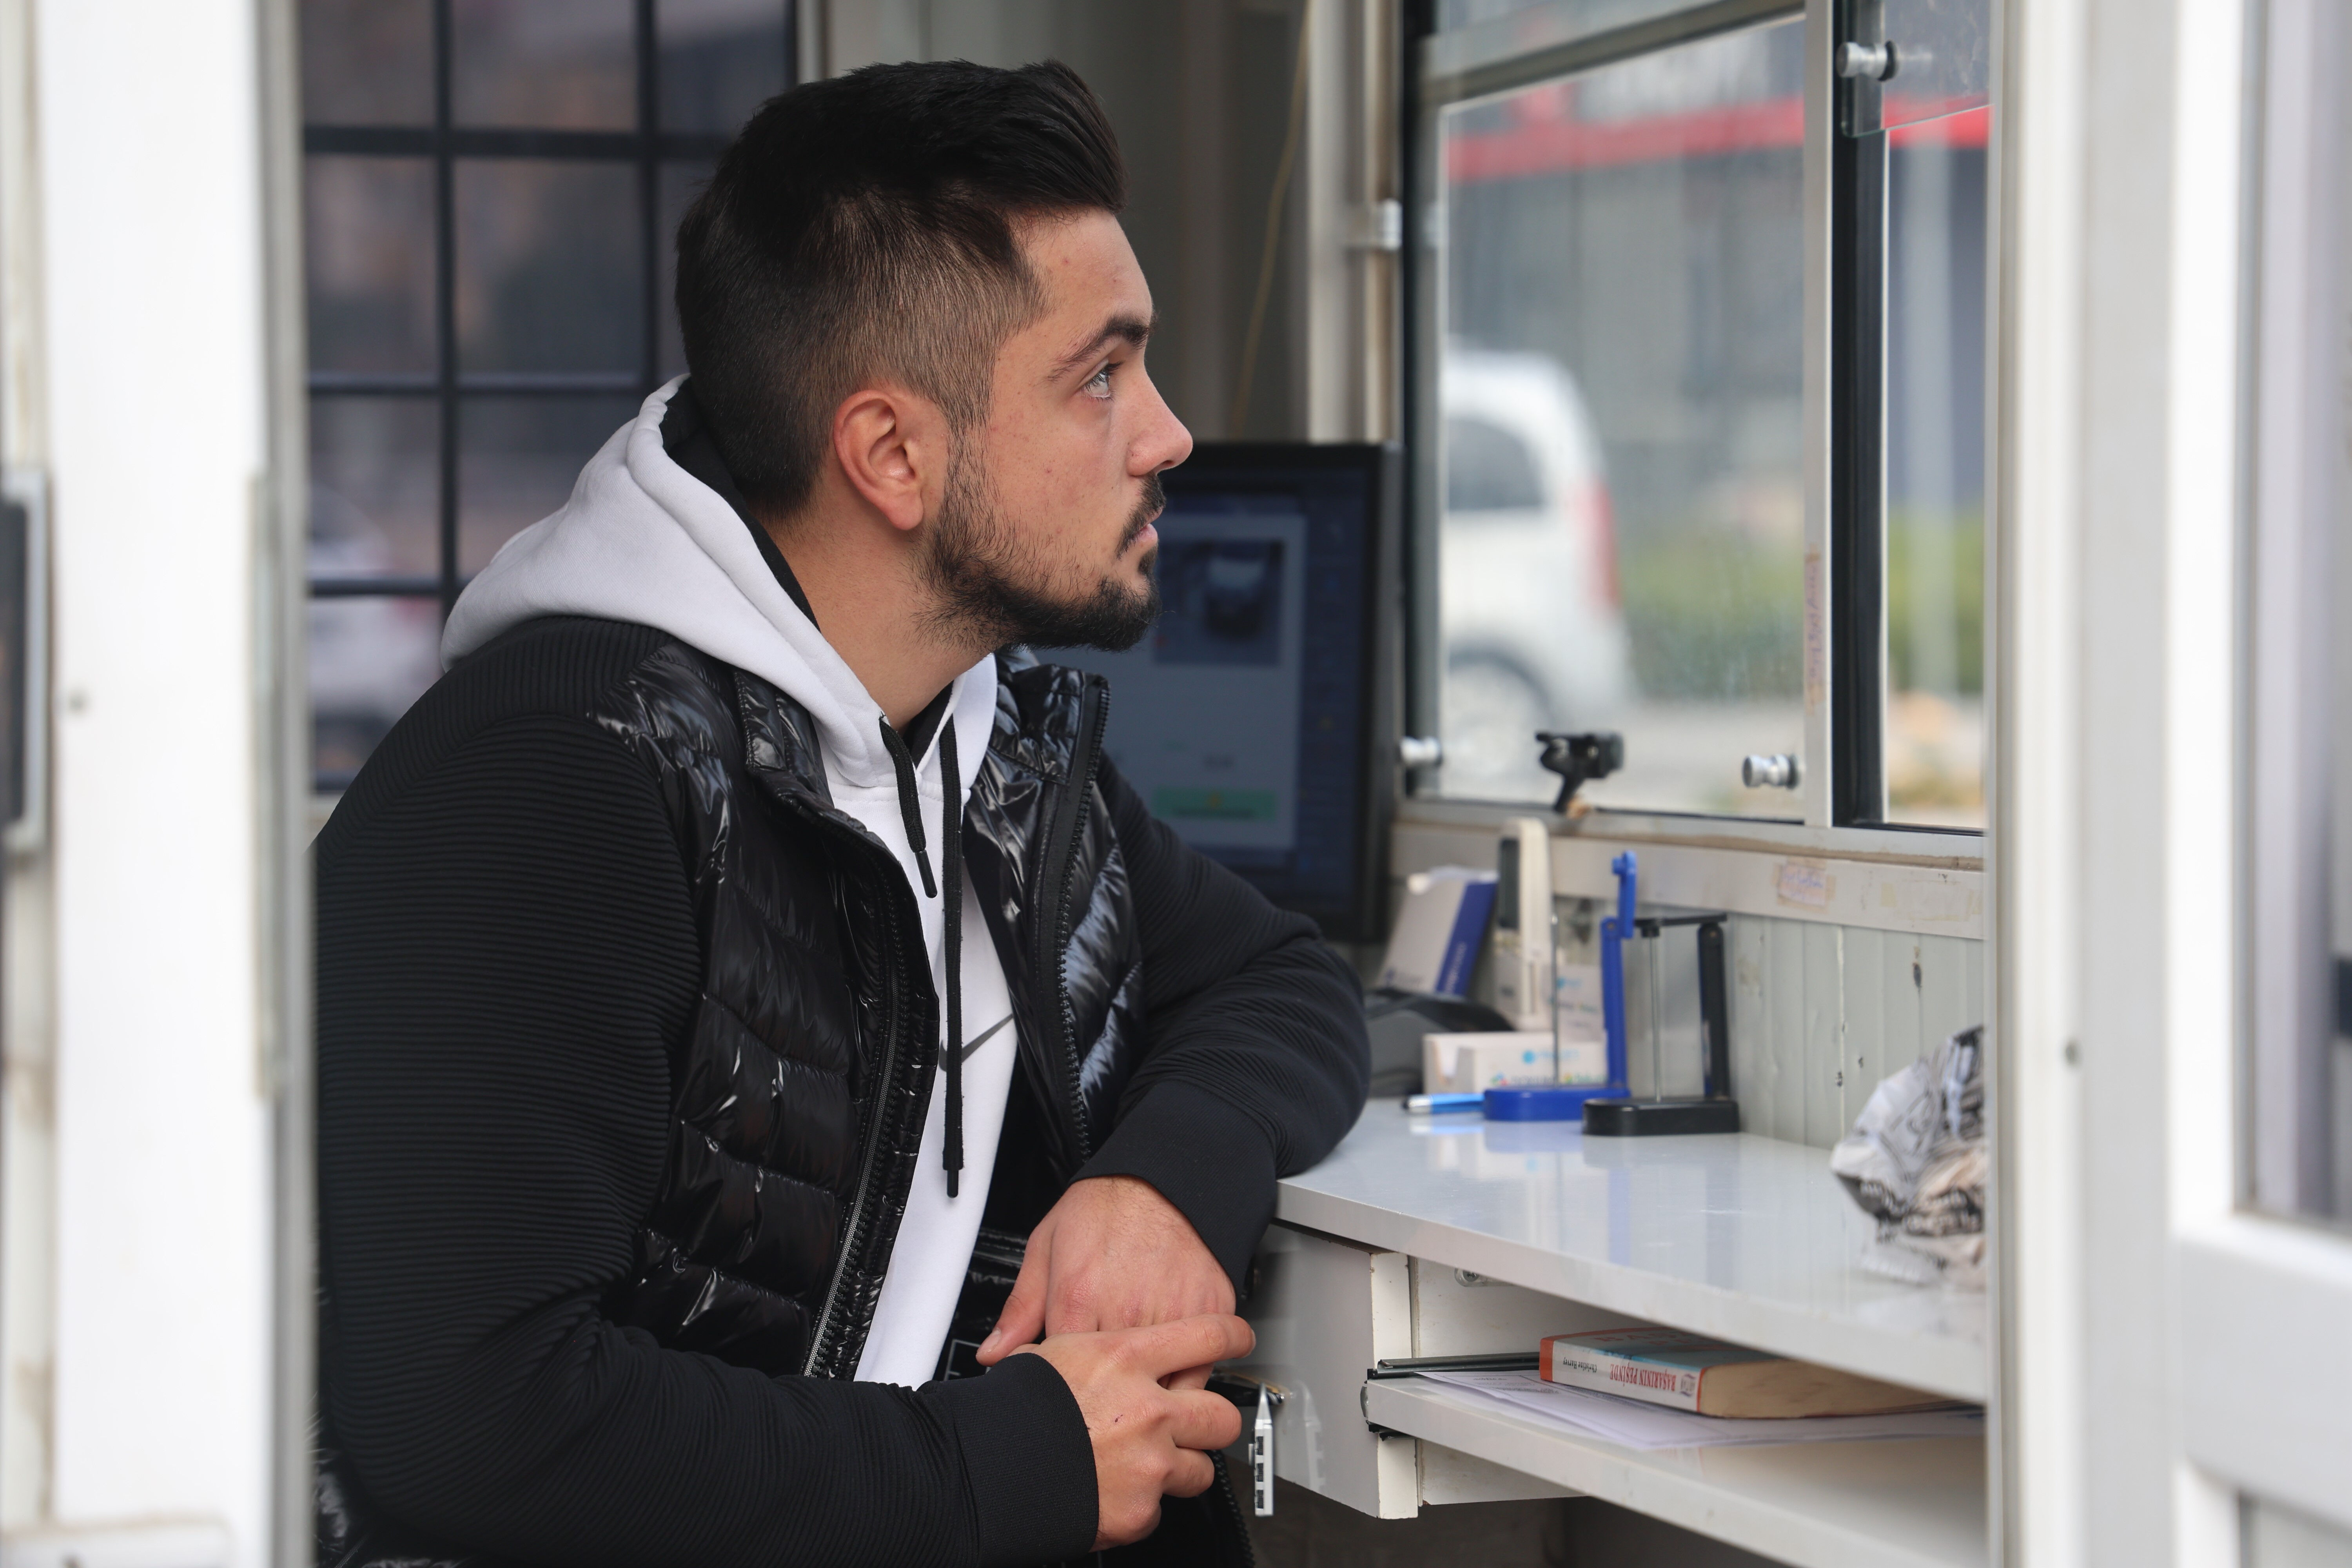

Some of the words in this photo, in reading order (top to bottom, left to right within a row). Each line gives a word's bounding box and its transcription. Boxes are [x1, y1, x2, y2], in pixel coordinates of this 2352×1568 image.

[1563, 1357, 1577, 1369] Harvey
[1578, 1361, 1597, 1373] Christine
[1610, 1362, 1638, 1387] PEŞİNDE
[1639, 1368, 1677, 1392] BAŞARININ
